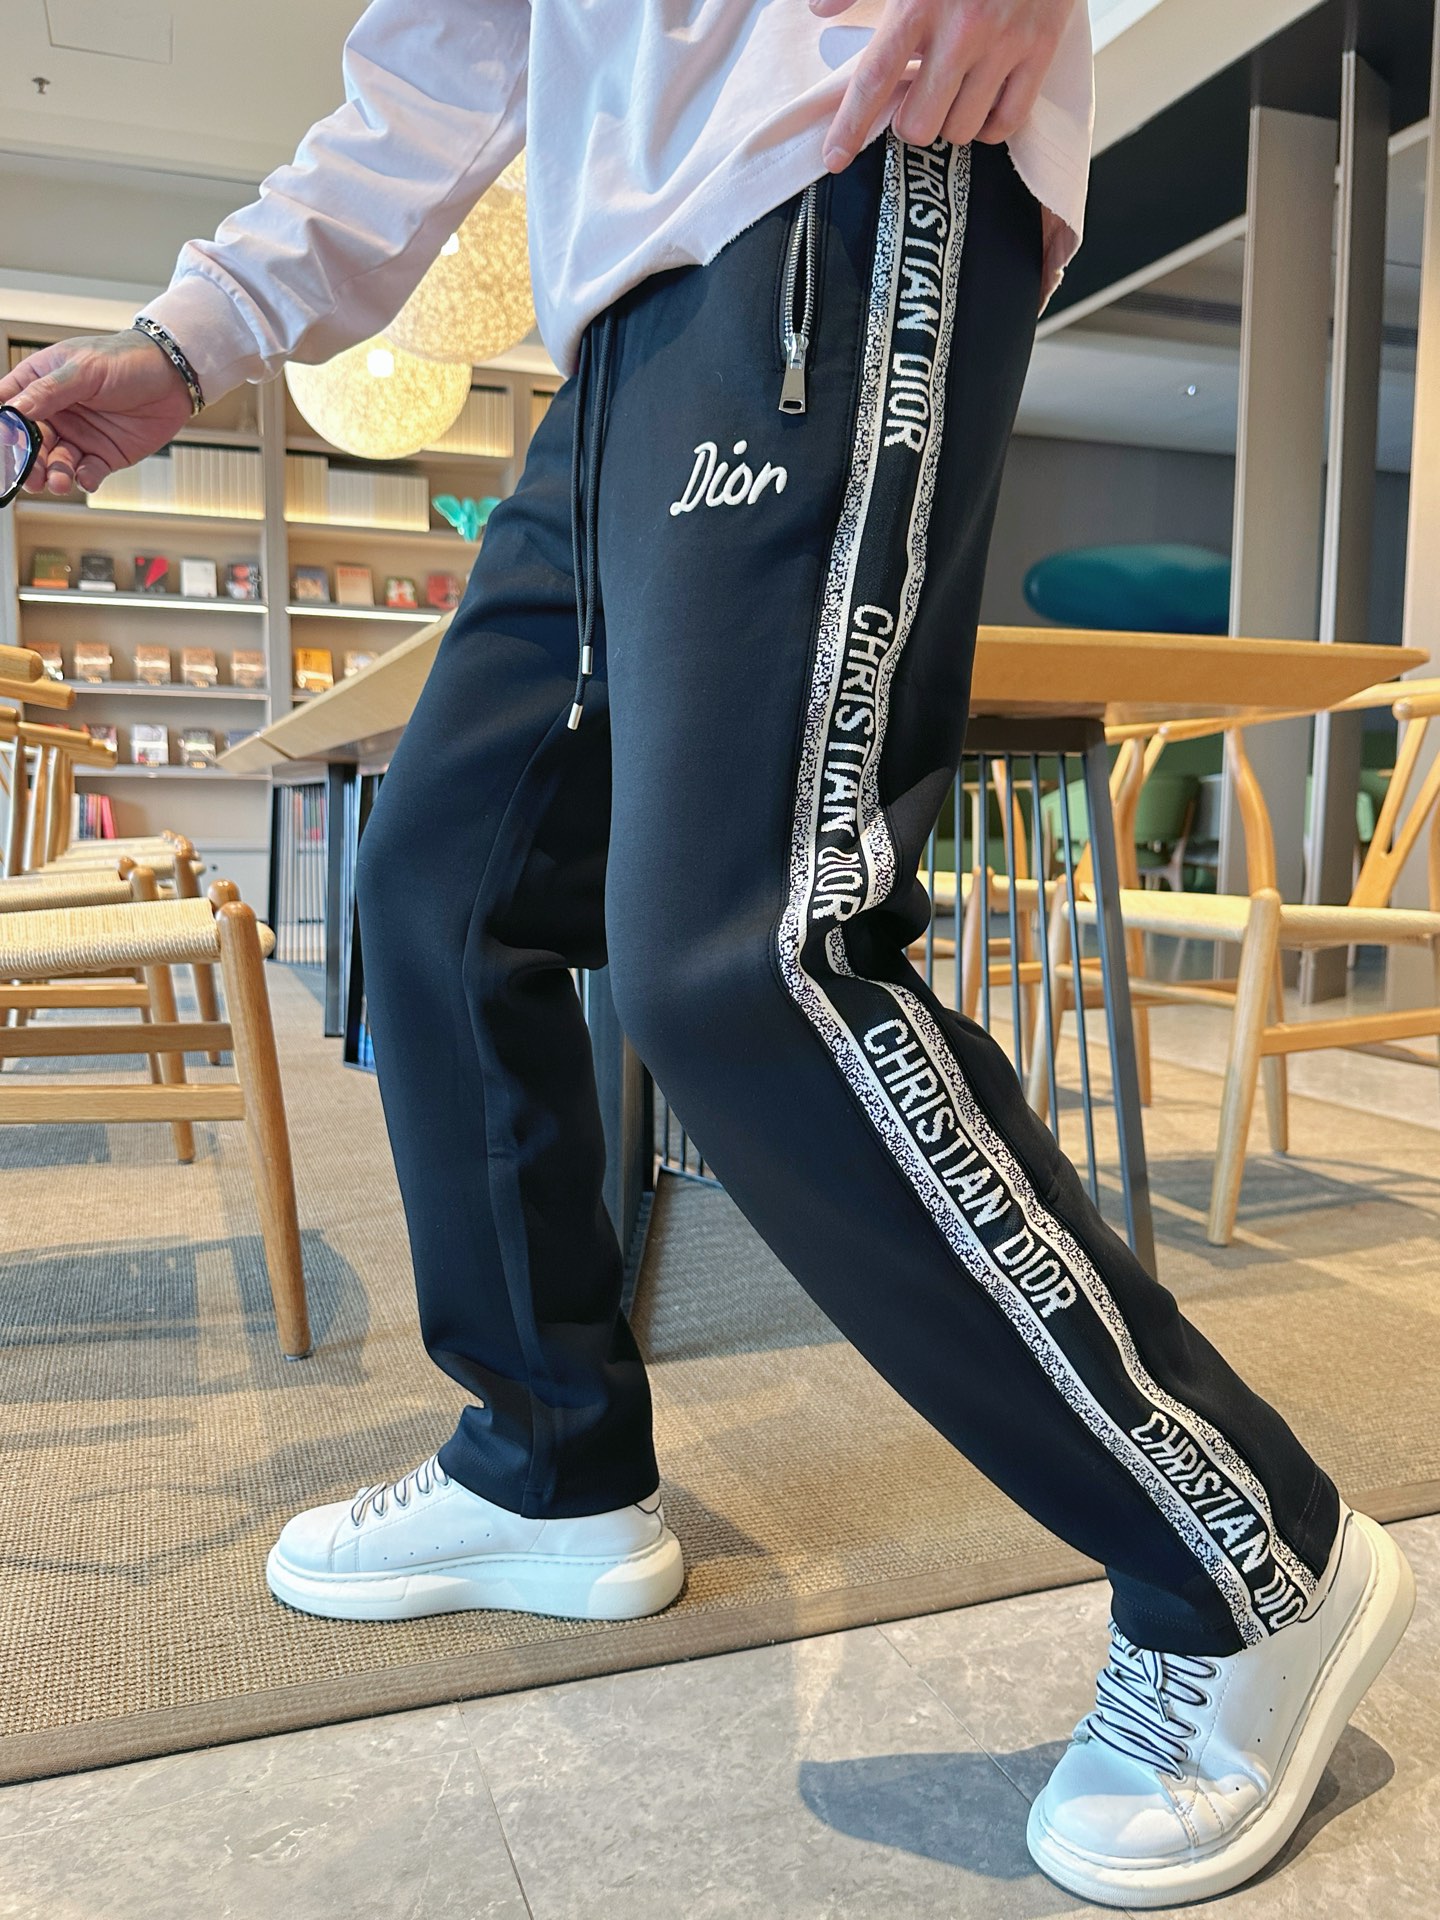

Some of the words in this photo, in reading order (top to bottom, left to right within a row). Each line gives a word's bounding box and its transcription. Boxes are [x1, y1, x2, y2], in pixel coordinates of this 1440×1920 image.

[884, 352, 932, 455] DIOR
[669, 439, 788, 517] Dior
[820, 603, 898, 838] CHRISTIAN
[812, 846, 864, 922] DIOR
[863, 1017, 1012, 1228] CHRISTIAN
[992, 1225, 1078, 1319] DIOR
[1130, 1410, 1269, 1574] CHRISTIAN
